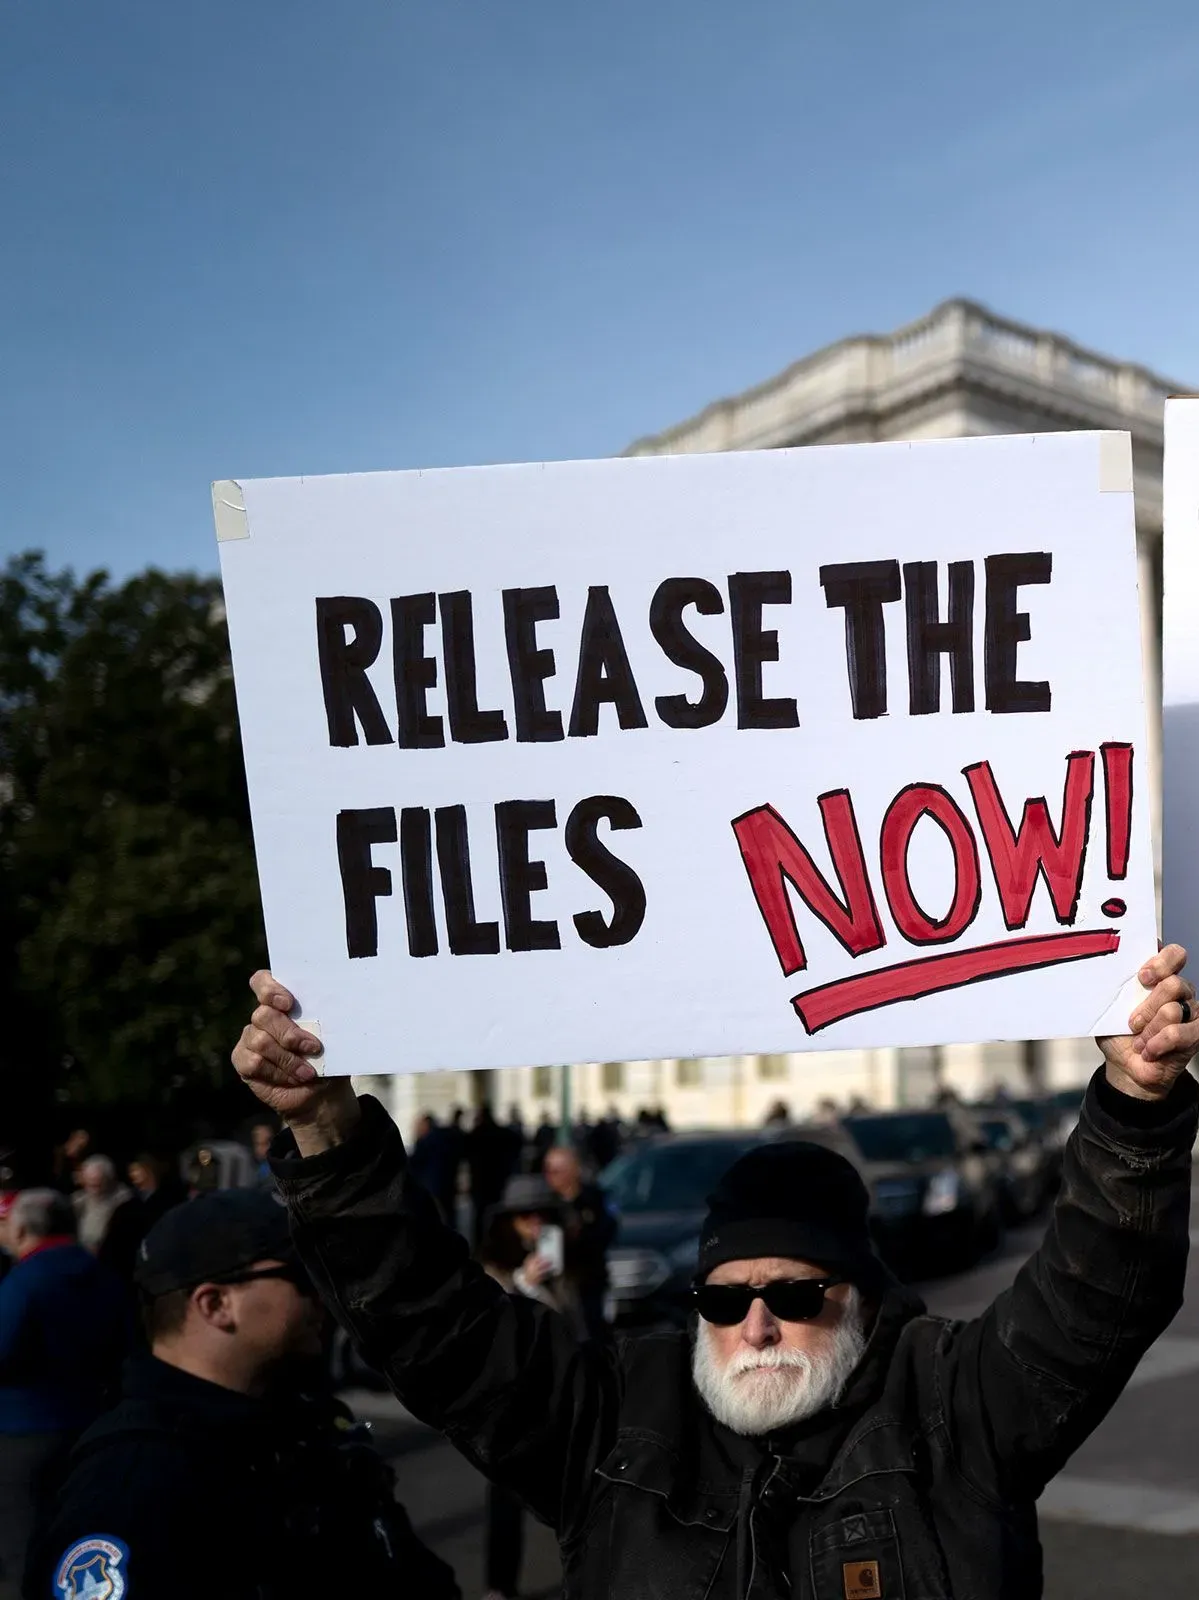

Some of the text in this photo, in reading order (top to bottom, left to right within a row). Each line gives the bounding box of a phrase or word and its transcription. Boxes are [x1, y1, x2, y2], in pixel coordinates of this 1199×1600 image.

[316, 551, 1053, 750] RELEASE THE
[336, 742, 1135, 978] FILES NOW!
